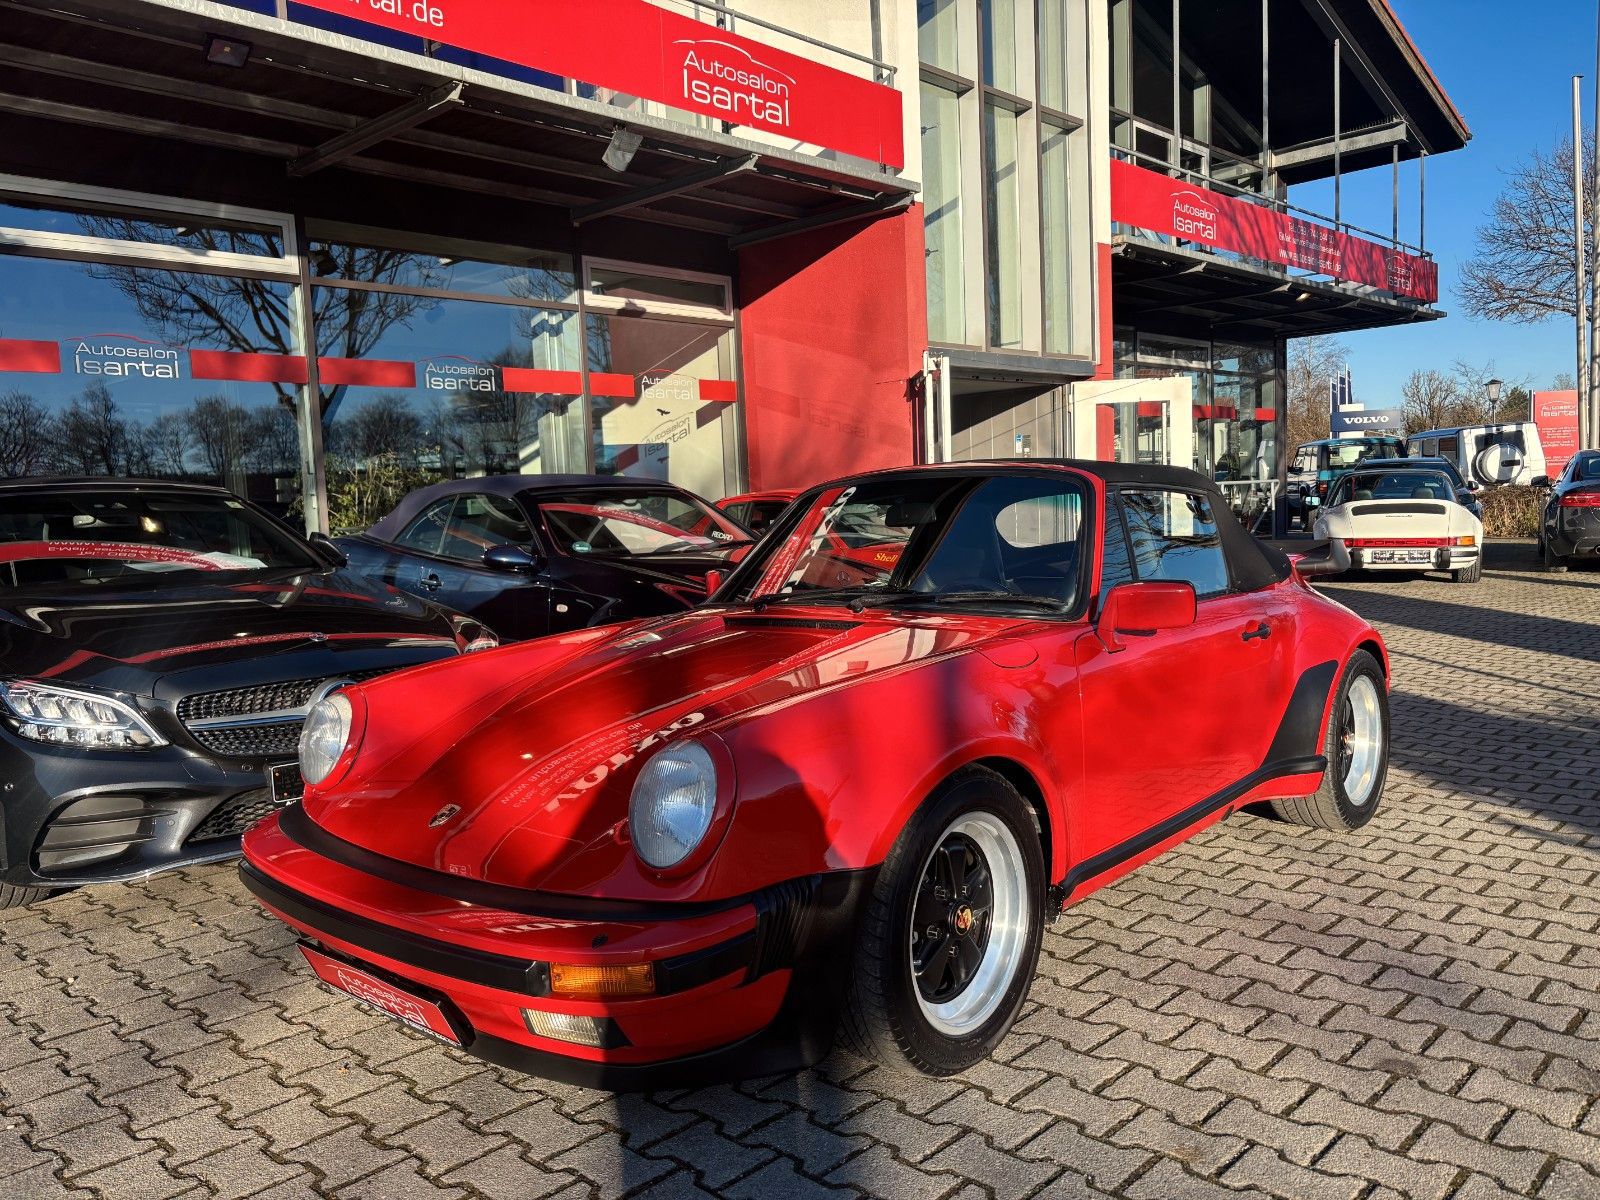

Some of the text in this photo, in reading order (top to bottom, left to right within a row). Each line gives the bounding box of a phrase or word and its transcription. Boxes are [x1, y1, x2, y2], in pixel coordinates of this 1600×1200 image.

[683, 50, 789, 99] Autosalon
[683, 69, 790, 127] Isartal
[1174, 199, 1216, 221] Autosalon
[1173, 210, 1217, 240] Isartal
[1386, 269, 1412, 291] Isartal
[75, 342, 178, 360] Autosalon
[75, 355, 180, 379] Isartal
[425, 362, 495, 376] Autosalon
[425, 372, 496, 392] Isartal
[641, 375, 694, 388] Autosalon
[641, 384, 694, 400] Isartal
[1343, 415, 1390, 425] VOLVO
[711, 530, 734, 541] RECARO
[874, 552, 899, 562] Shell
[337, 969, 422, 1010] Autosalon
[338, 976, 432, 1029] Isartal
